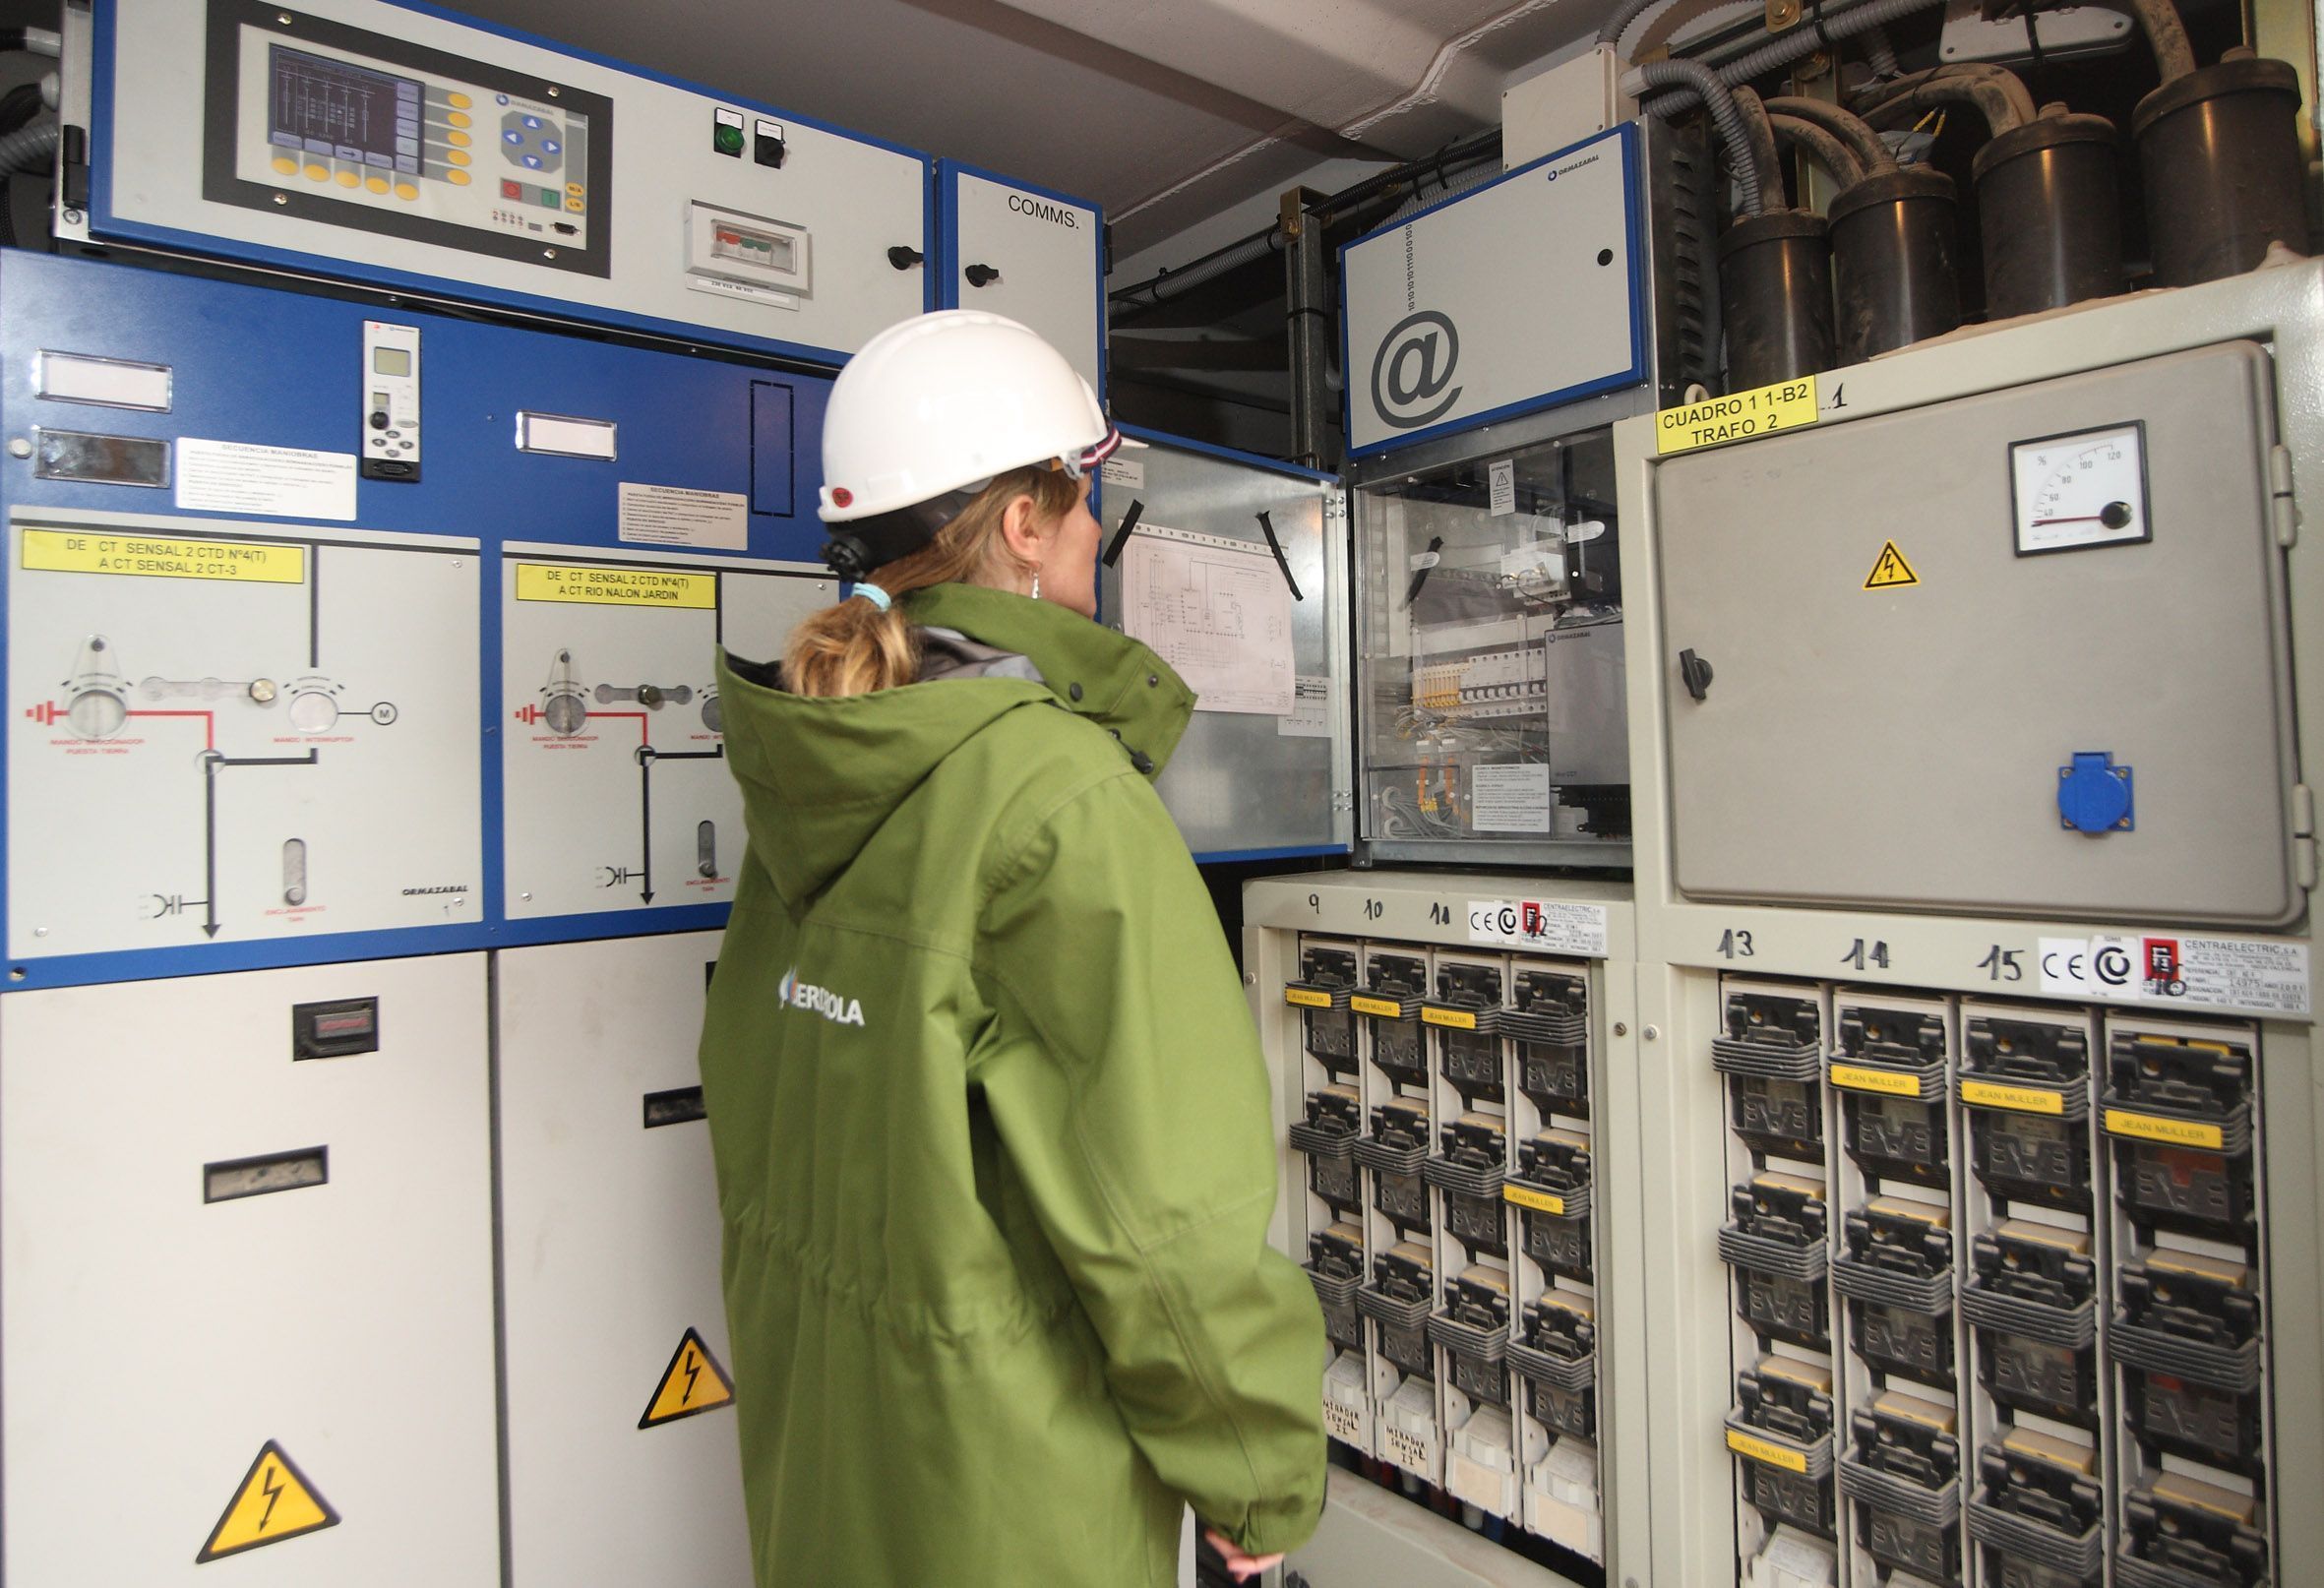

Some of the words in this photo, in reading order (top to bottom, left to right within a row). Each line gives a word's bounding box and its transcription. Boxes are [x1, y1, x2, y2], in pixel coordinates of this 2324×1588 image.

[1559, 154, 1599, 175] ORMAZABAL
[1009, 195, 1079, 229] COMMS.
[1371, 310, 1463, 429] @
[1832, 382, 1848, 408] 1
[1663, 398, 1742, 429] CUADRO
[1765, 383, 1808, 406] 1-B2
[1691, 418, 1755, 445] TRAFO
[1767, 413, 1778, 430] 2
[221, 444, 269, 454] SECUENCIA
[2108, 451, 2121, 460] 120
[2079, 460, 2093, 469] 100
[2061, 475, 2071, 484] 80
[67, 538, 86, 551] DE
[98, 540, 117, 553] CT
[126, 542, 180, 557] SENSAL
[186, 546, 193, 558] 2
[197, 546, 223, 559] CTD
[98, 558, 108, 568] A
[113, 558, 132, 570] CT
[137, 560, 191, 574] SENSAL
[196, 563, 203, 574] 2
[208, 563, 236, 576] CT-3
[547, 571, 561, 580] DE
[570, 572, 582, 581] CT
[589, 574, 629, 584] SENSAL
[631, 576, 637, 584] 2
[640, 576, 658, 585] CTD
[559, 585, 566, 594] A
[569, 585, 581, 595] CT
[585, 586, 603, 596] RIO
[606, 587, 641, 598] NALON
[642, 589, 679, 600] JARDIN
[379, 709, 390, 718] M
[401, 886, 468, 896] ORMAZABAL
[1309, 893, 1319, 915] 9
[1364, 898, 1383, 921] 10
[1716, 928, 1754, 959] 13
[1840, 938, 1890, 970] 14
[1976, 944, 2025, 981] 15
[1843, 1072, 1866, 1082] JEAN
[1975, 1089, 2001, 1100] JEAN
[2120, 1120, 2151, 1131] JEAN
[1385, 1426, 1426, 1449] MIRADOR
[1391, 1437, 1426, 1460] SENSAL
